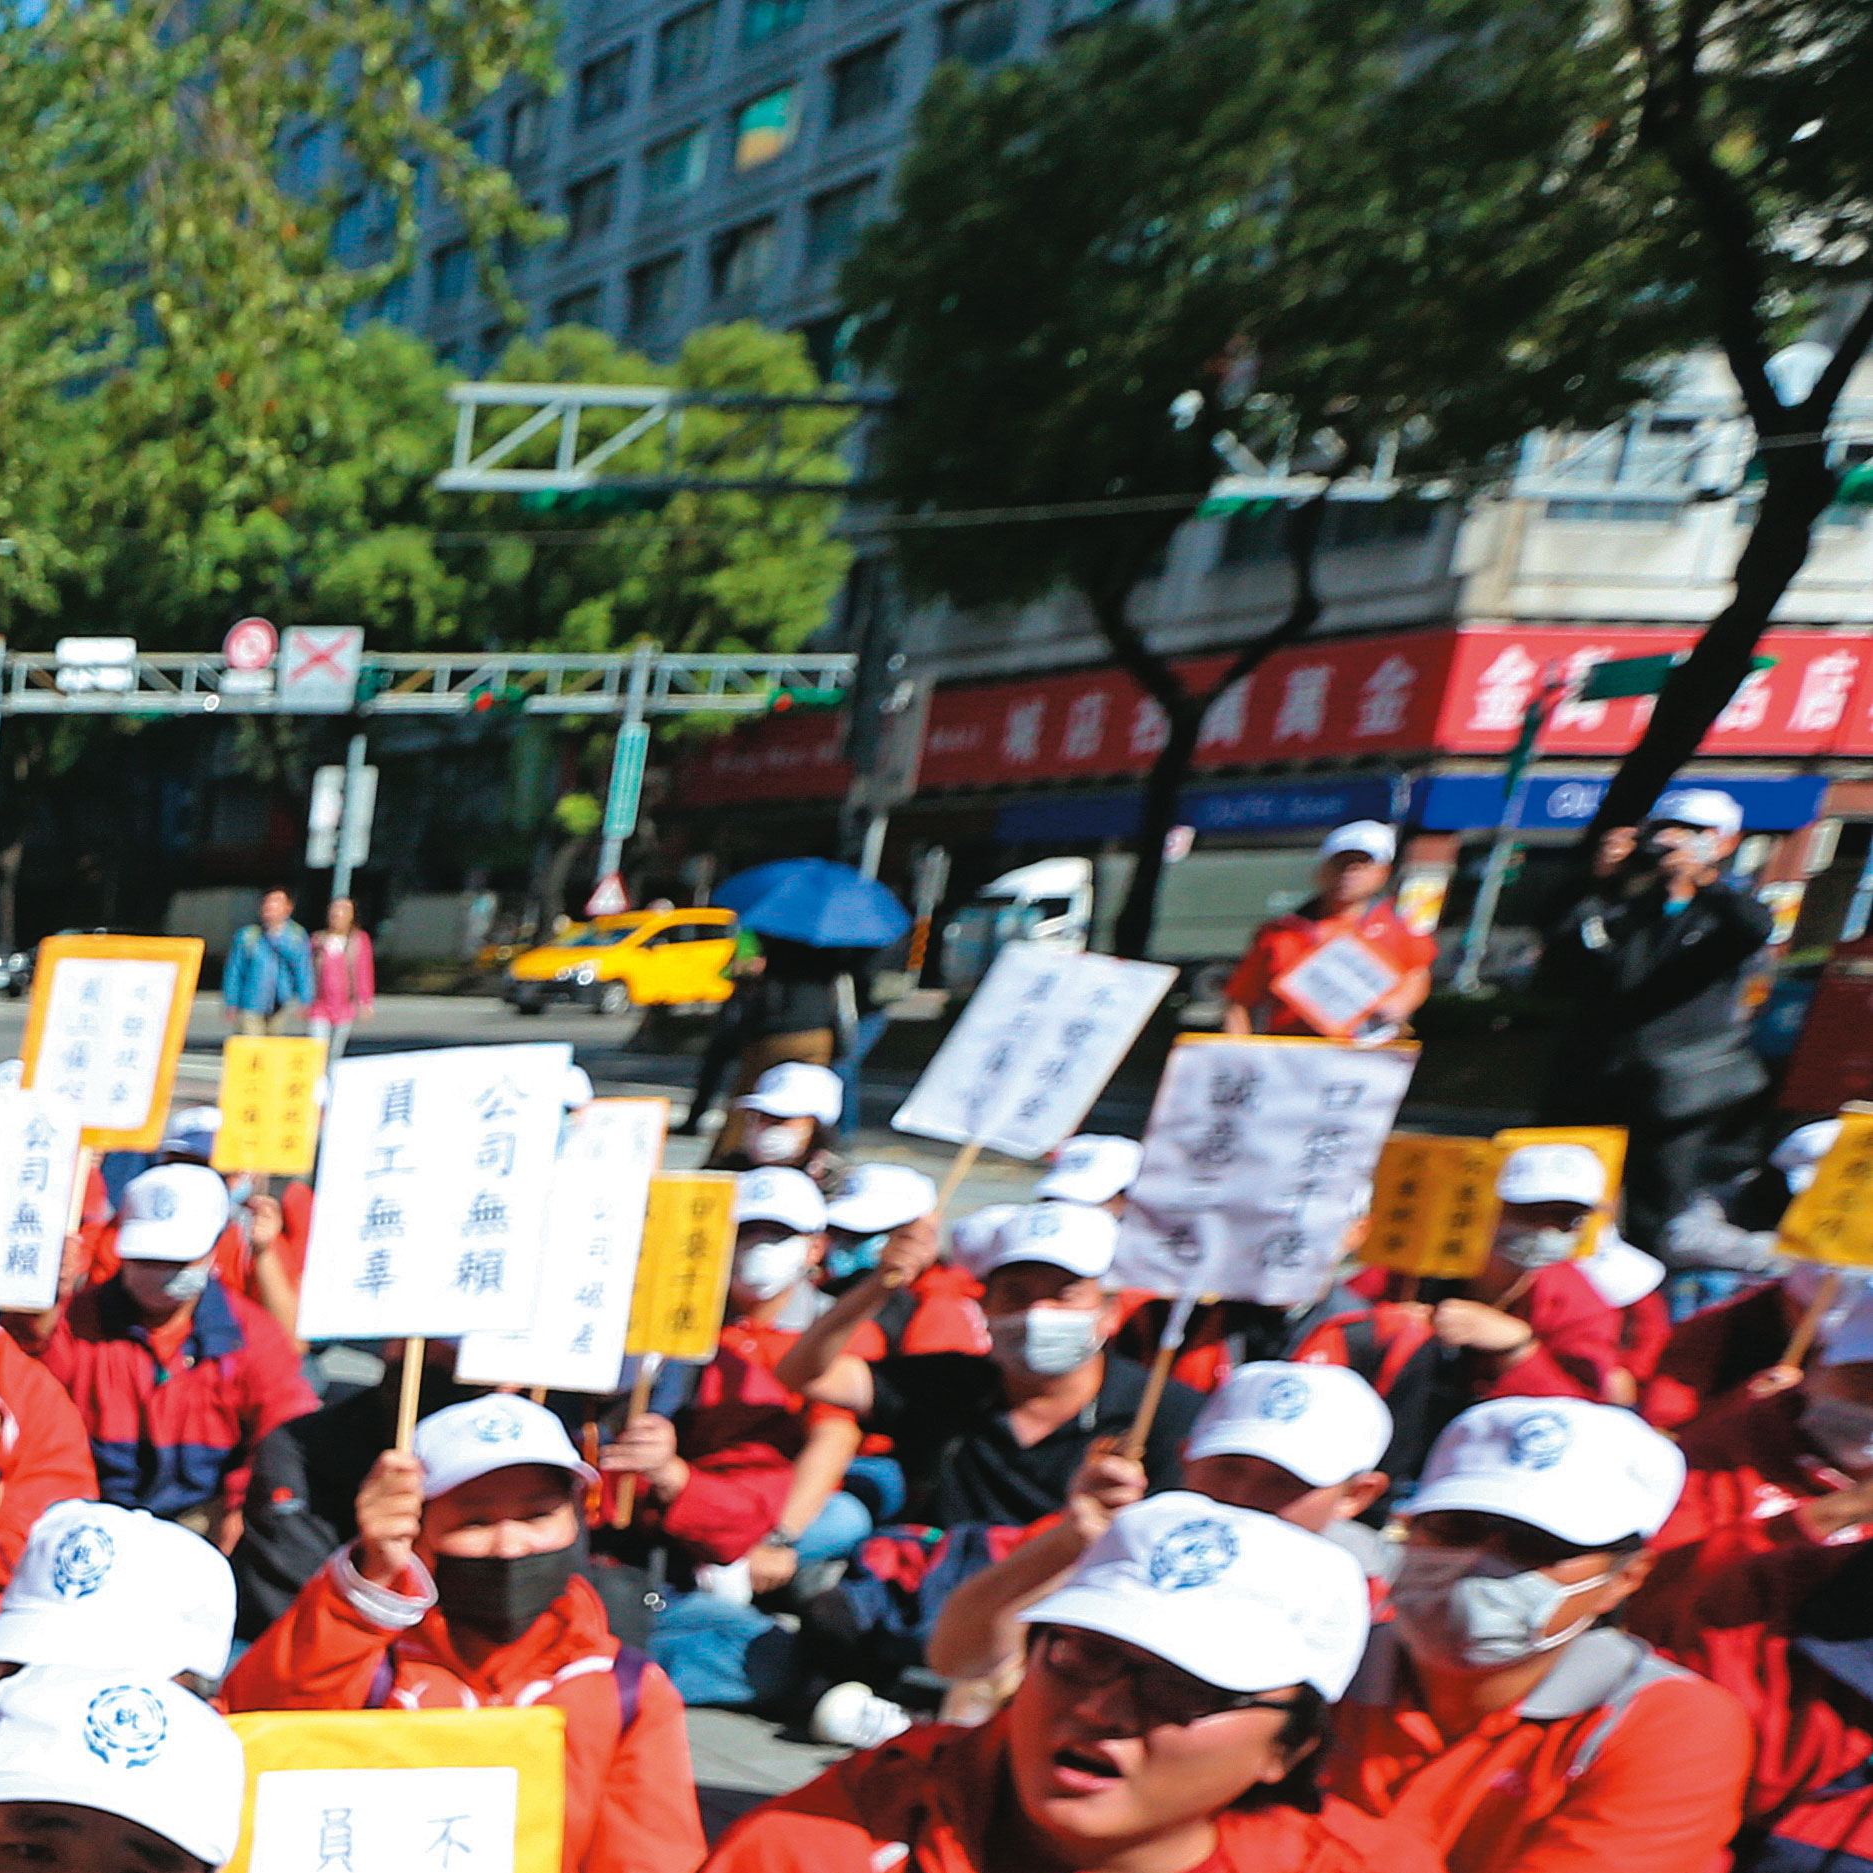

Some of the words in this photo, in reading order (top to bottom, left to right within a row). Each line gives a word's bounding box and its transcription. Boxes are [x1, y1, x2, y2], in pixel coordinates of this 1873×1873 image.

[4, 1111, 58, 1277] 公司無賴
[451, 1074, 530, 1295] 公司無賴
